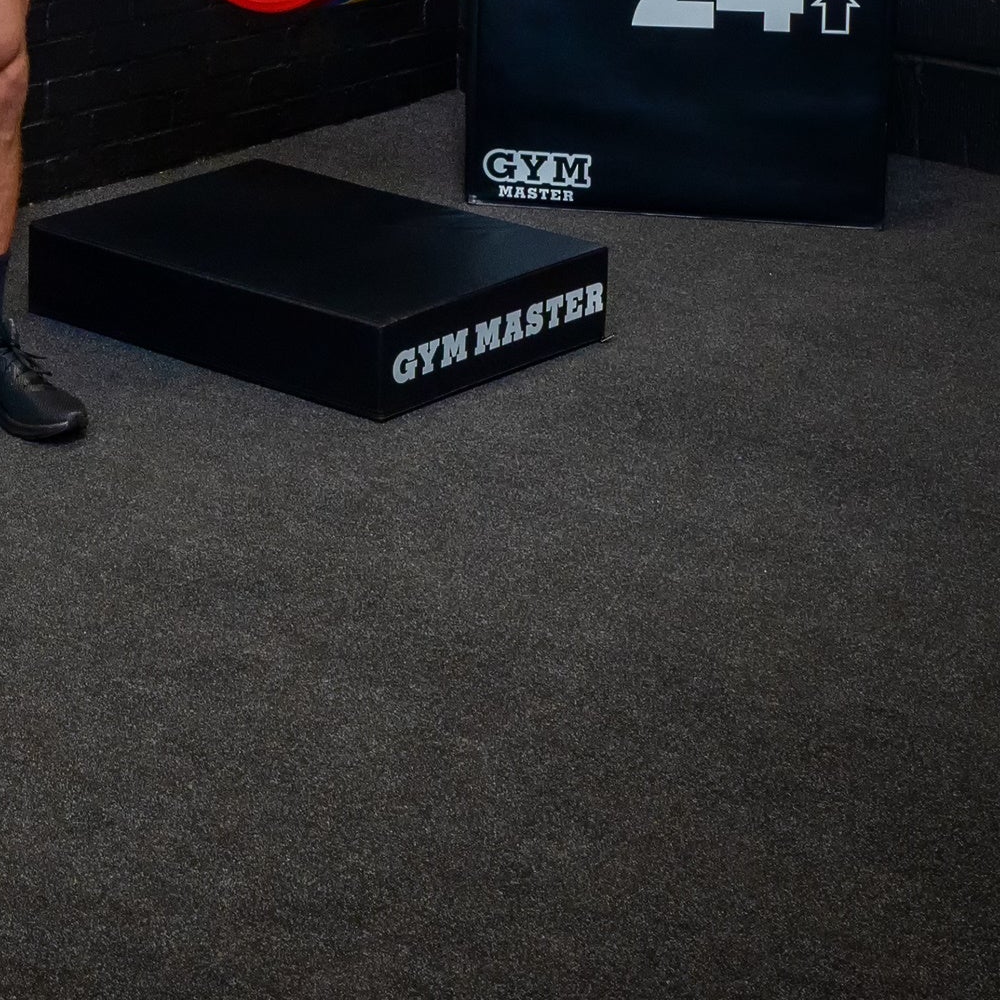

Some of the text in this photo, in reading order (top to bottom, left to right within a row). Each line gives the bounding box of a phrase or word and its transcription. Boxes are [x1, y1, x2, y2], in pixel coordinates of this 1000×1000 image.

[482, 148, 592, 188] GYM
[498, 185, 574, 201] MASTER
[392, 282, 604, 384] GYM MASTER
